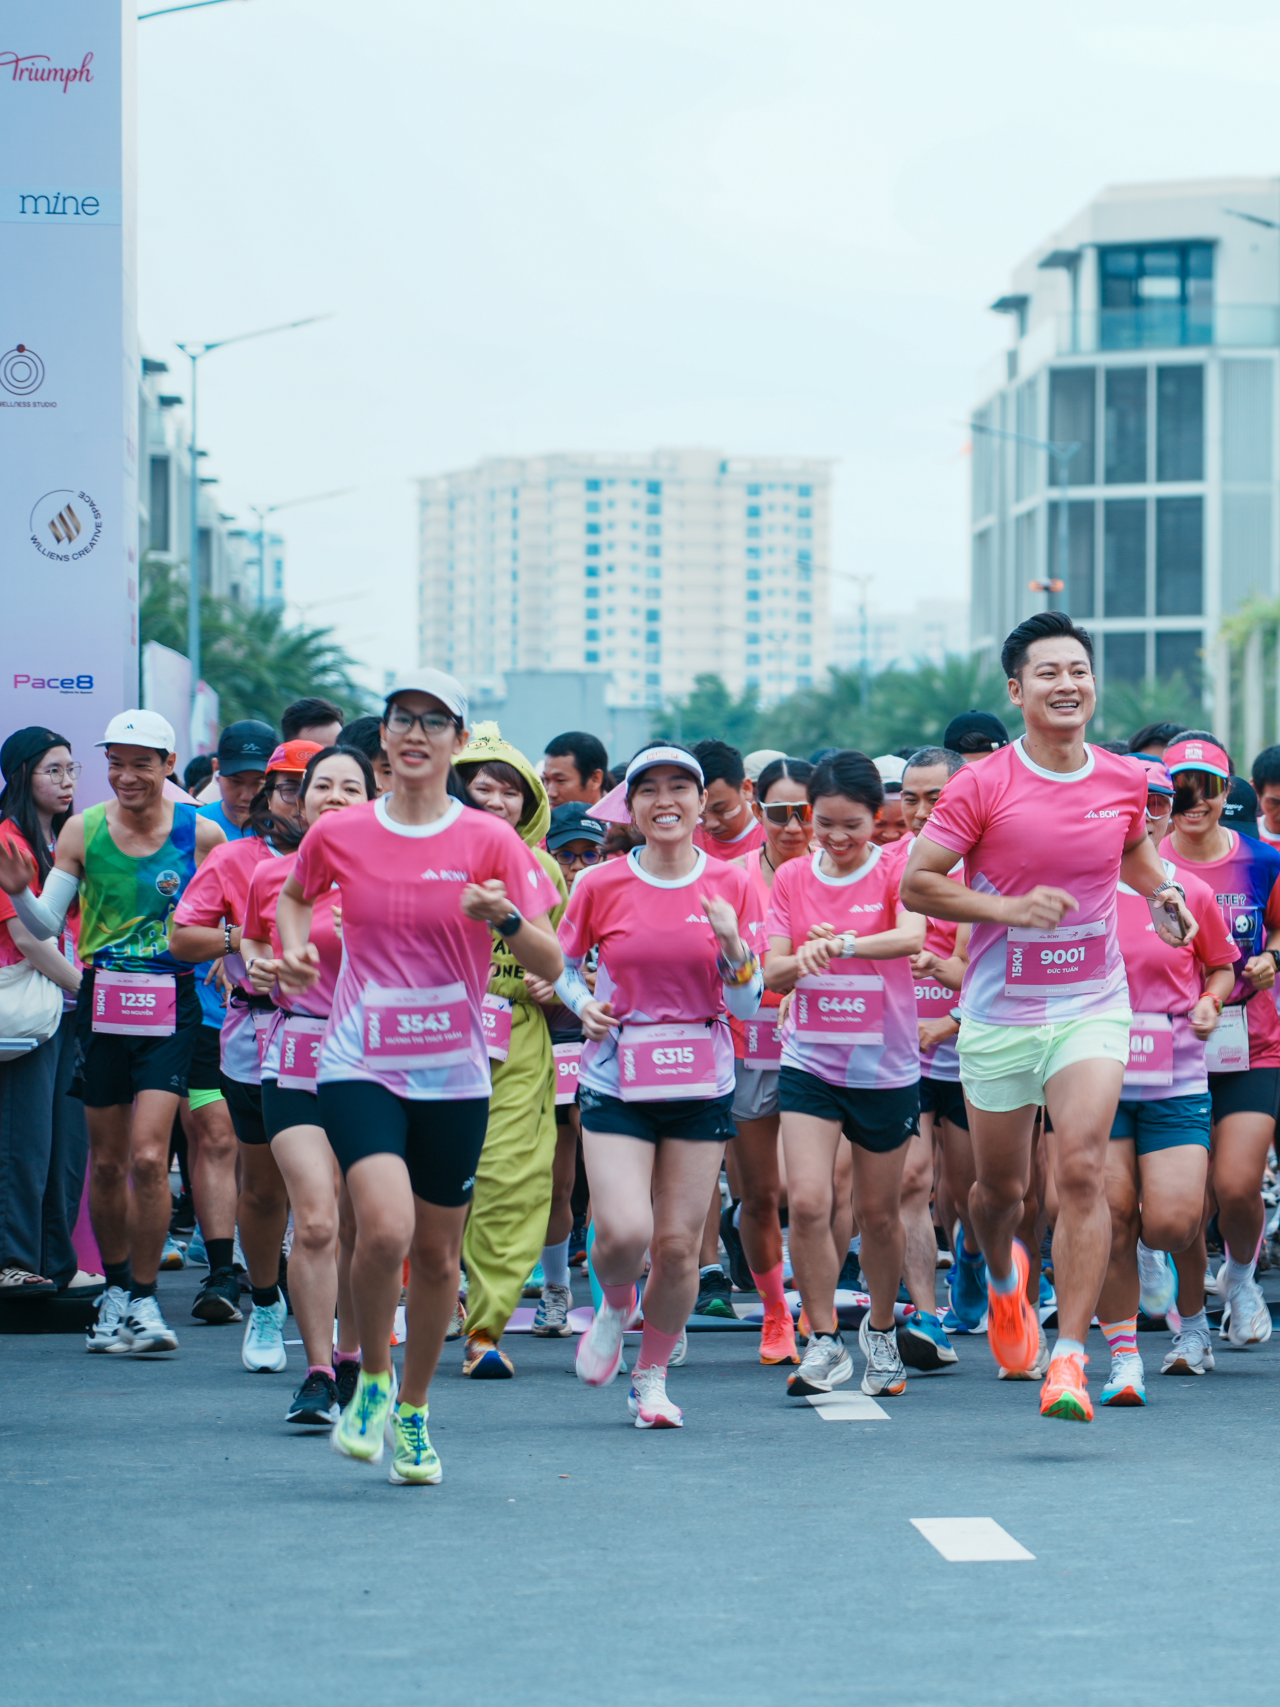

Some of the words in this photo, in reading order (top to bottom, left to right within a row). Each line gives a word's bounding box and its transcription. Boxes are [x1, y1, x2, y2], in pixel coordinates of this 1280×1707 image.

[0, 51, 94, 93] Triumph
[19, 192, 100, 216] mine
[77, 490, 103, 520] SPACE
[30, 534, 70, 562] WILLIENS
[71, 521, 103, 562] CREATIVE
[14, 674, 94, 690] Pace8
[1100, 810, 1120, 818] BCNV
[1216, 894, 1246, 905] ETE?
[1012, 948, 1023, 978] 15KM
[1040, 946, 1086, 965] 9001
[96, 989, 107, 1016] 15KM
[119, 993, 157, 1008] 1235
[914, 986, 955, 1001] 9100
[818, 997, 867, 1014] 6446
[396, 1011, 451, 1034] 3543
[285, 1037, 296, 1069] 15KM
[652, 1047, 695, 1065] 6315
